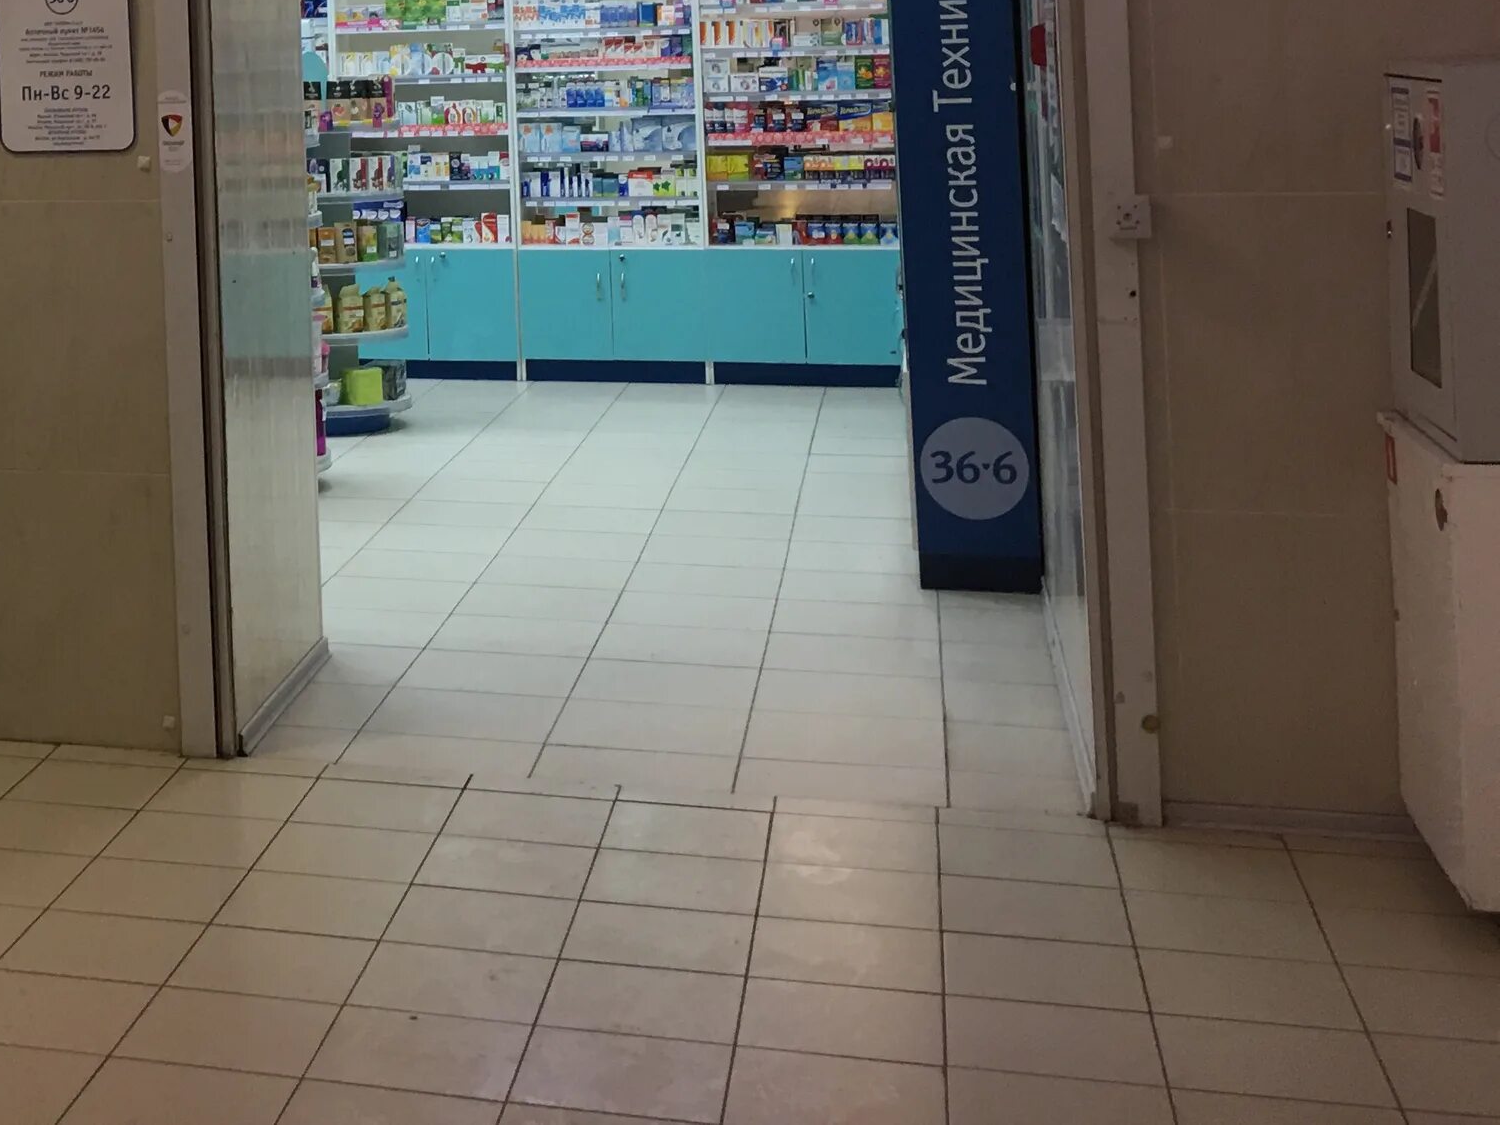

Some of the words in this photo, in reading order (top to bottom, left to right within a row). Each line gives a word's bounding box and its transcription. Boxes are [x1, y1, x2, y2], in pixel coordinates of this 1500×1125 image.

[66, 69, 93, 77] РАБОТЫ
[22, 85, 69, 101] Пн-Вс
[74, 84, 111, 100] 9-22
[946, 124, 992, 386] Медицинская
